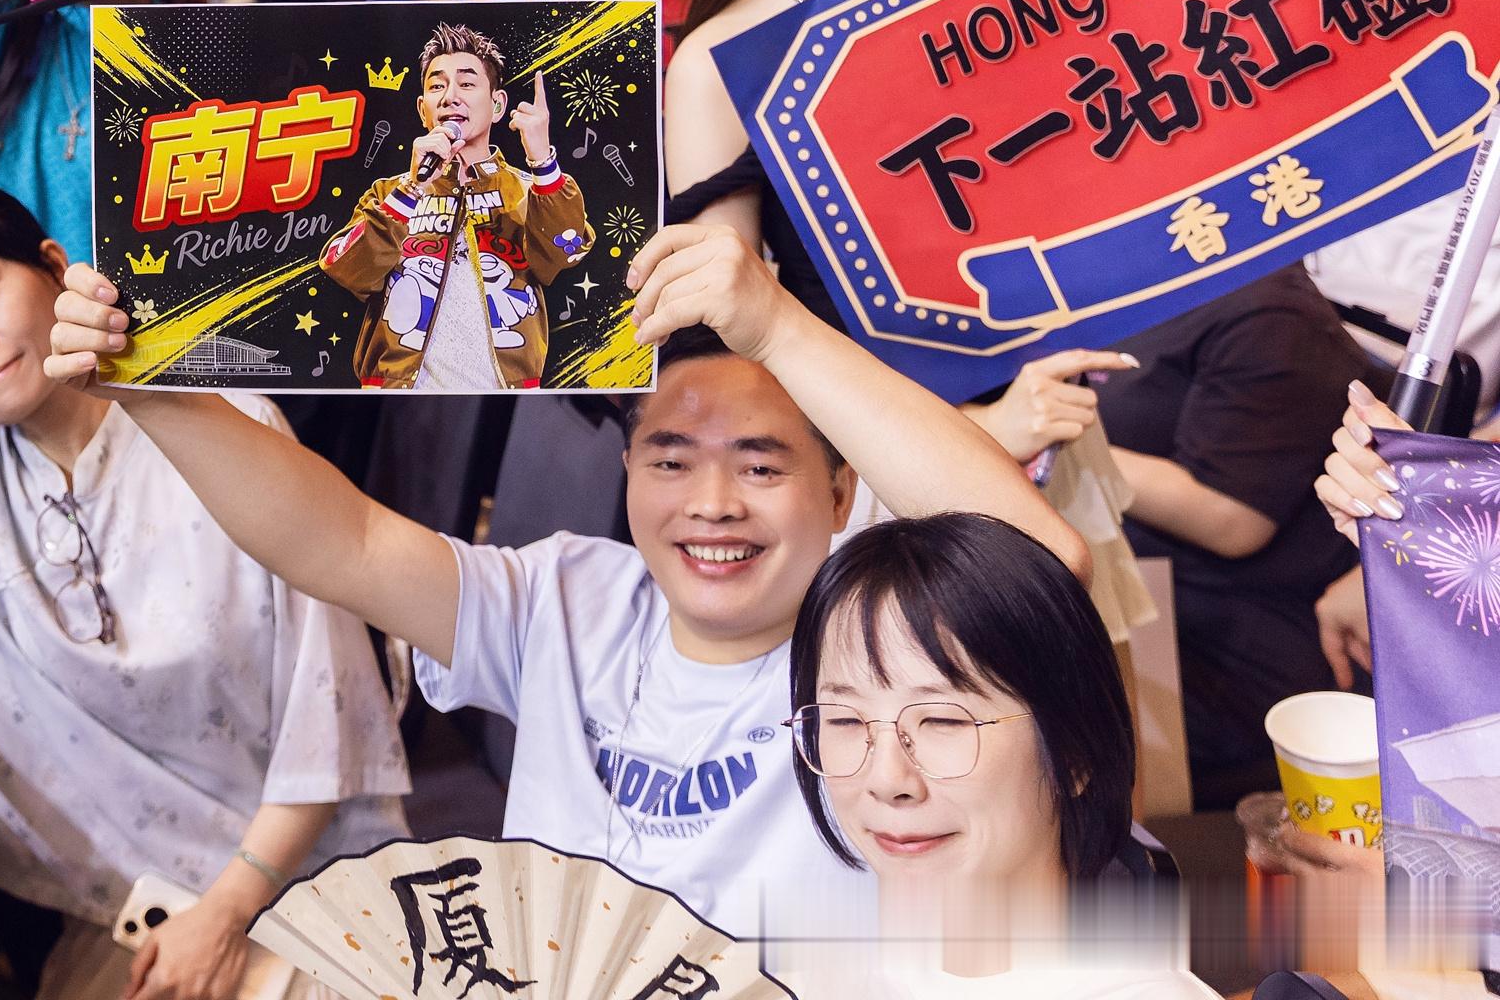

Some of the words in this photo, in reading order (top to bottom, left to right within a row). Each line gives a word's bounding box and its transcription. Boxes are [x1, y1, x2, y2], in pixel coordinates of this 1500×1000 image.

[140, 92, 357, 224] 南宁
[174, 221, 271, 271] Richie
[276, 209, 332, 256] Jen
[1167, 154, 1324, 264] 香港
[630, 817, 716, 839] MARIN
